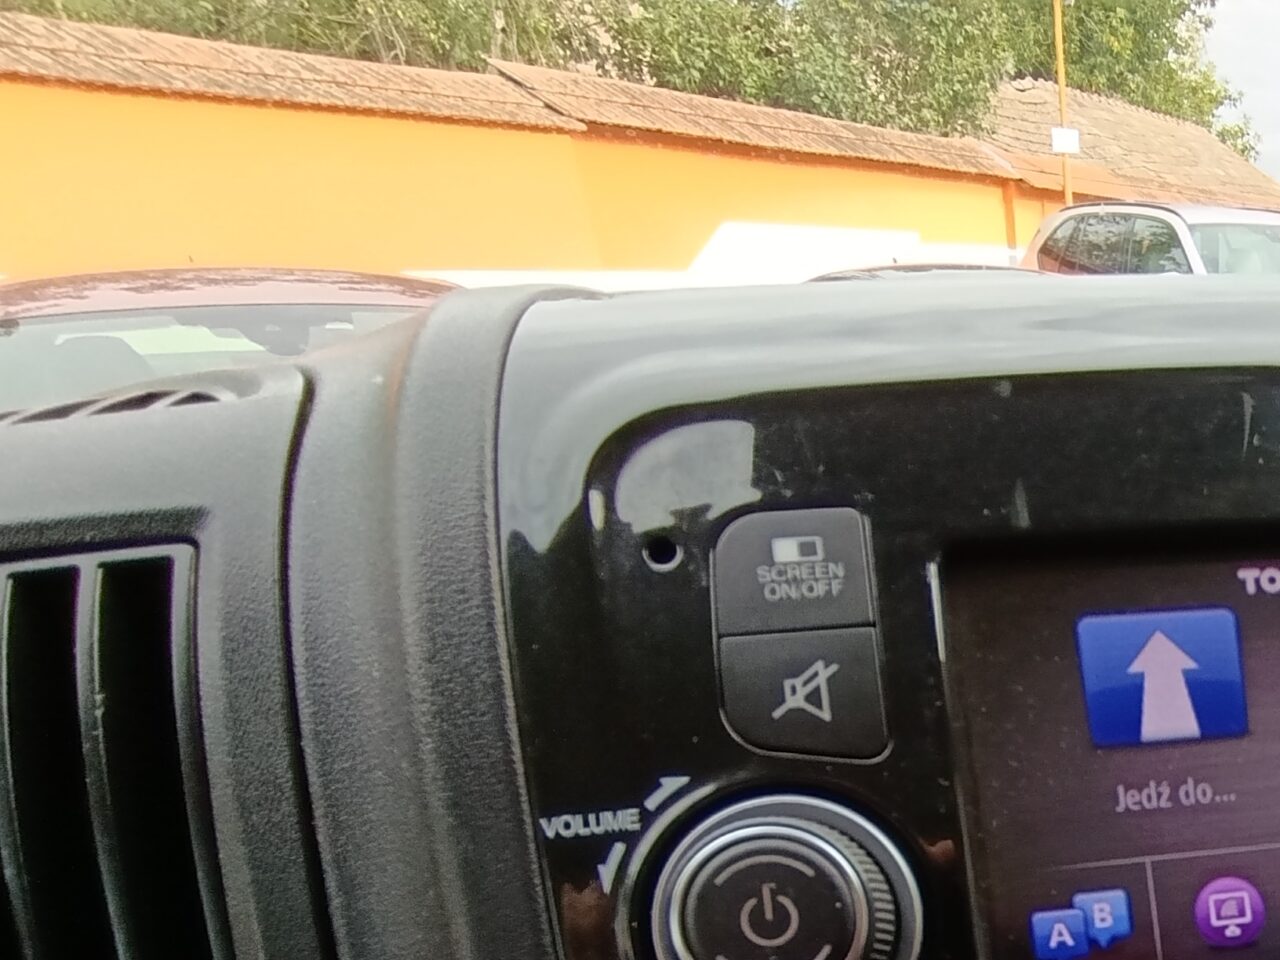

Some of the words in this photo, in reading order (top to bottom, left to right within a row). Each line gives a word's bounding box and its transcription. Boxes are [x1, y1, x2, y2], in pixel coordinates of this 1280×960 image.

[756, 562, 845, 583] SCREEN
[1115, 779, 1173, 813] Jedź
[1178, 776, 1237, 806] do...
[539, 808, 642, 839] VOLUME
